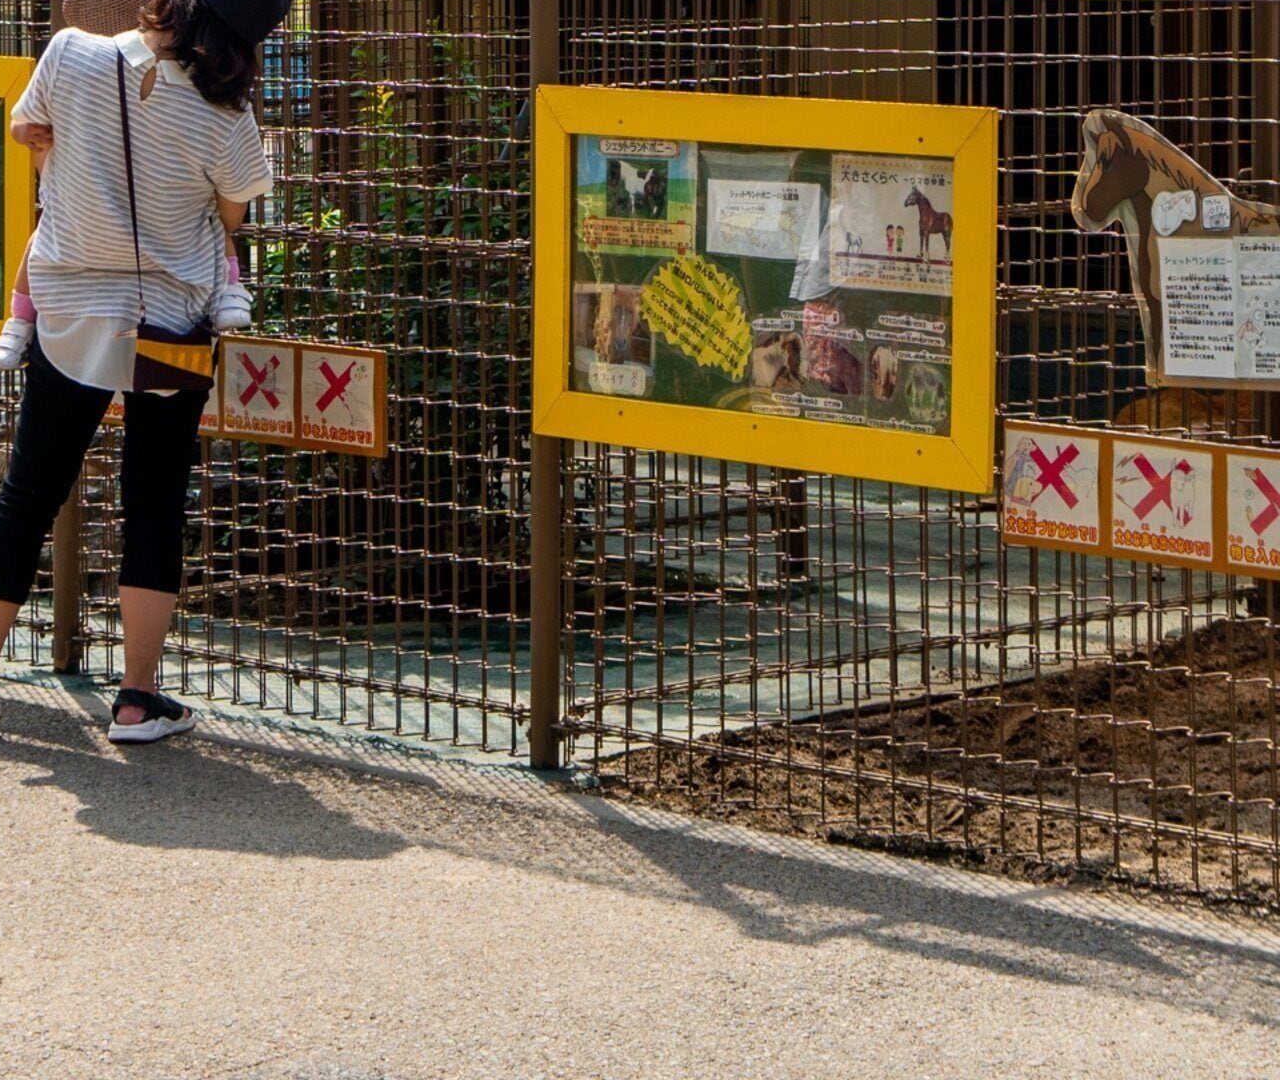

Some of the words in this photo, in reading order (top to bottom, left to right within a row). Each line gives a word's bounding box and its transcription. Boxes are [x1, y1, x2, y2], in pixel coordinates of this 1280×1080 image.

[604, 139, 673, 153] シェットランドポニー
[841, 170, 899, 185] 大きさくらべ
